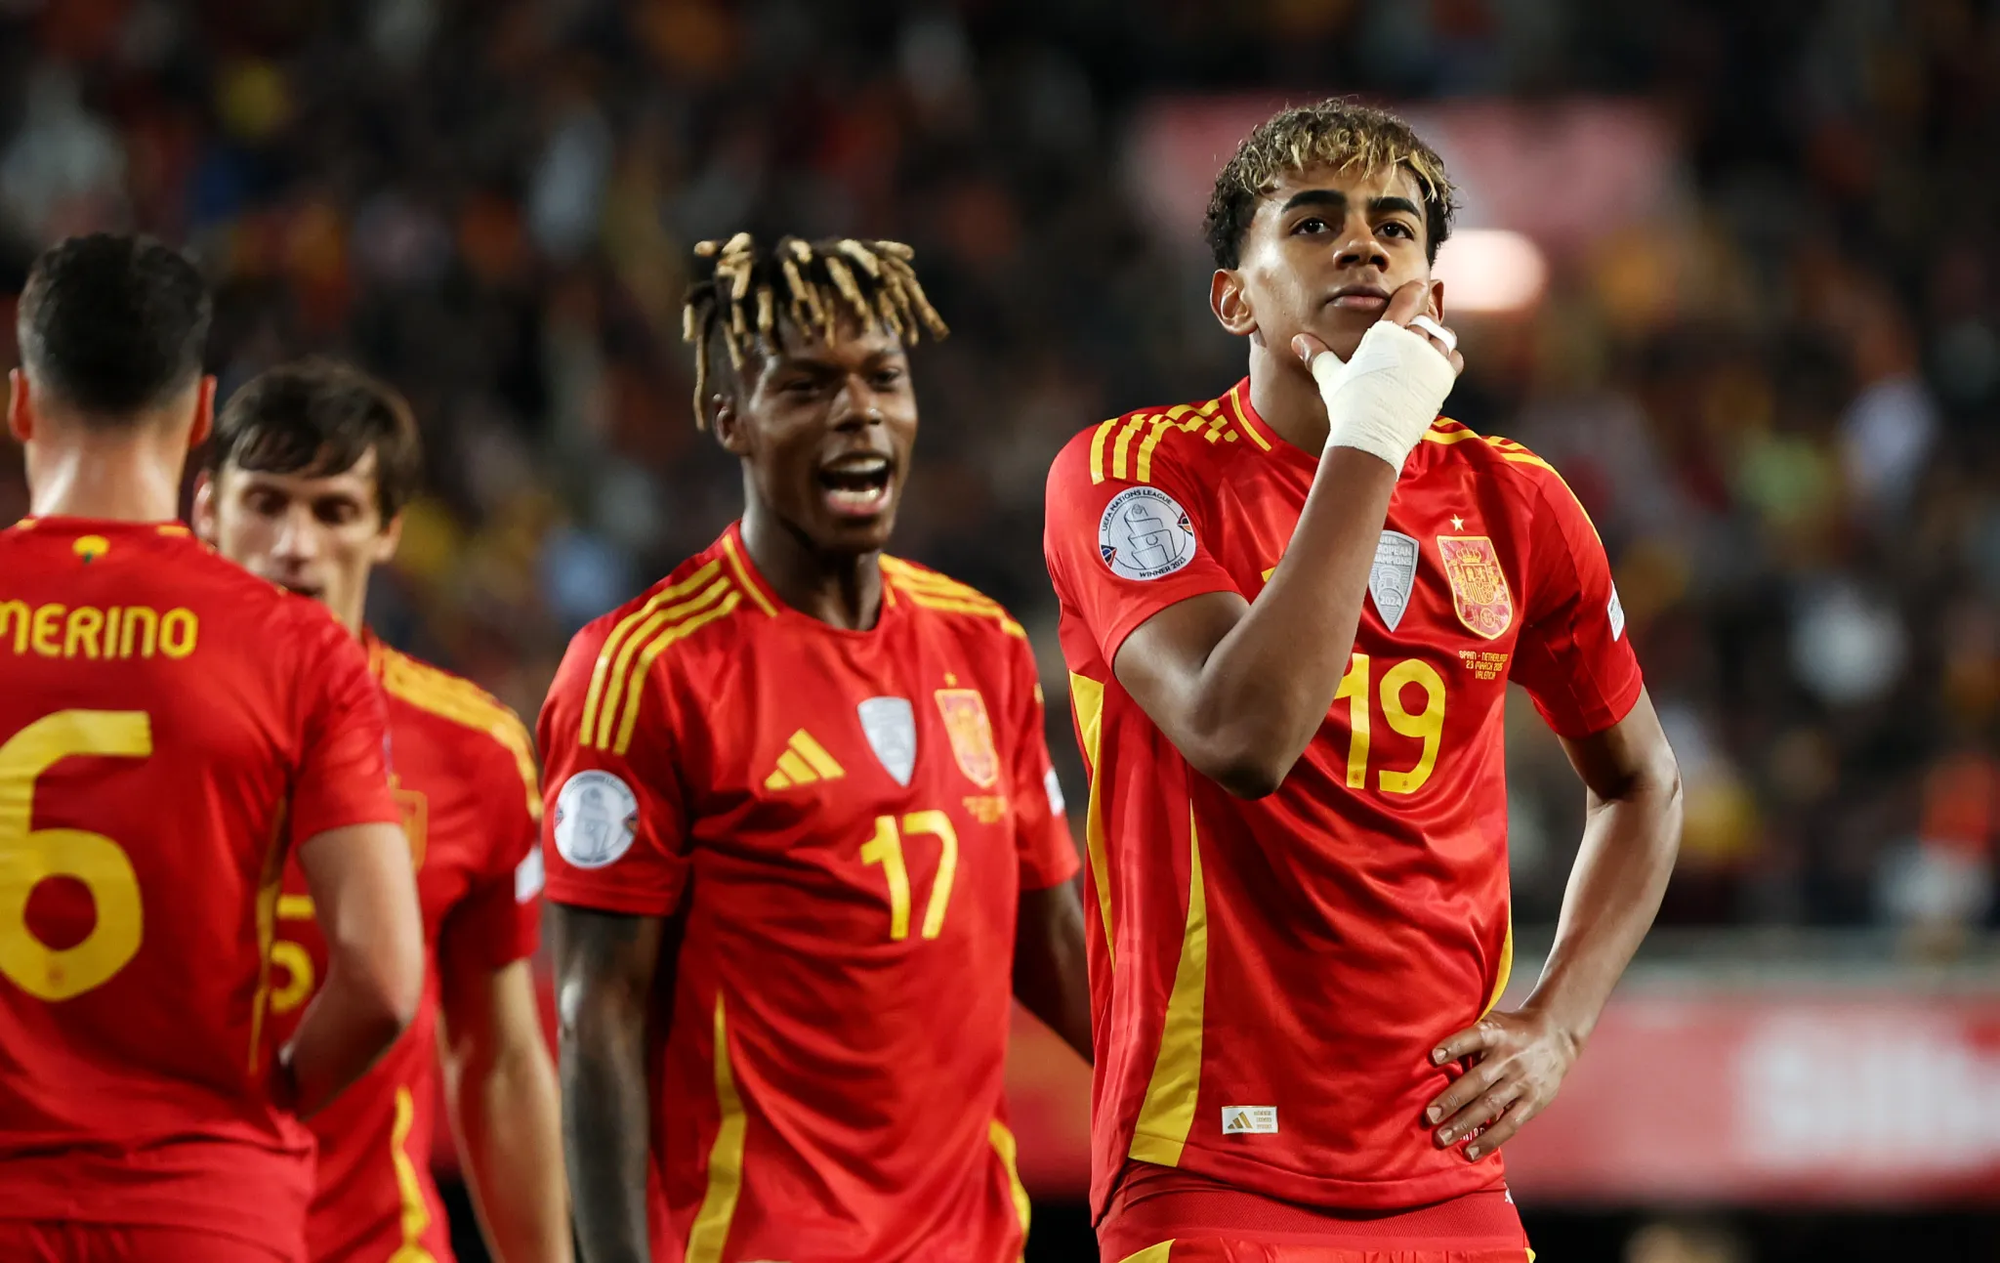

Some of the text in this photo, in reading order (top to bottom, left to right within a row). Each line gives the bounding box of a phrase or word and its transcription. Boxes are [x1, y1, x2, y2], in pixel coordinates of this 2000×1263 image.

[1102, 489, 1173, 531] UEFA NATIONS LEAGUE
[1139, 566, 1171, 577] WINNER
[0, 599, 199, 660] MERINO
[1459, 650, 1477, 660] SPAIN
[1466, 660, 1474, 669] 23
[1334, 652, 1446, 794] 19
[0, 708, 153, 1002] 6
[860, 810, 958, 940] 17
